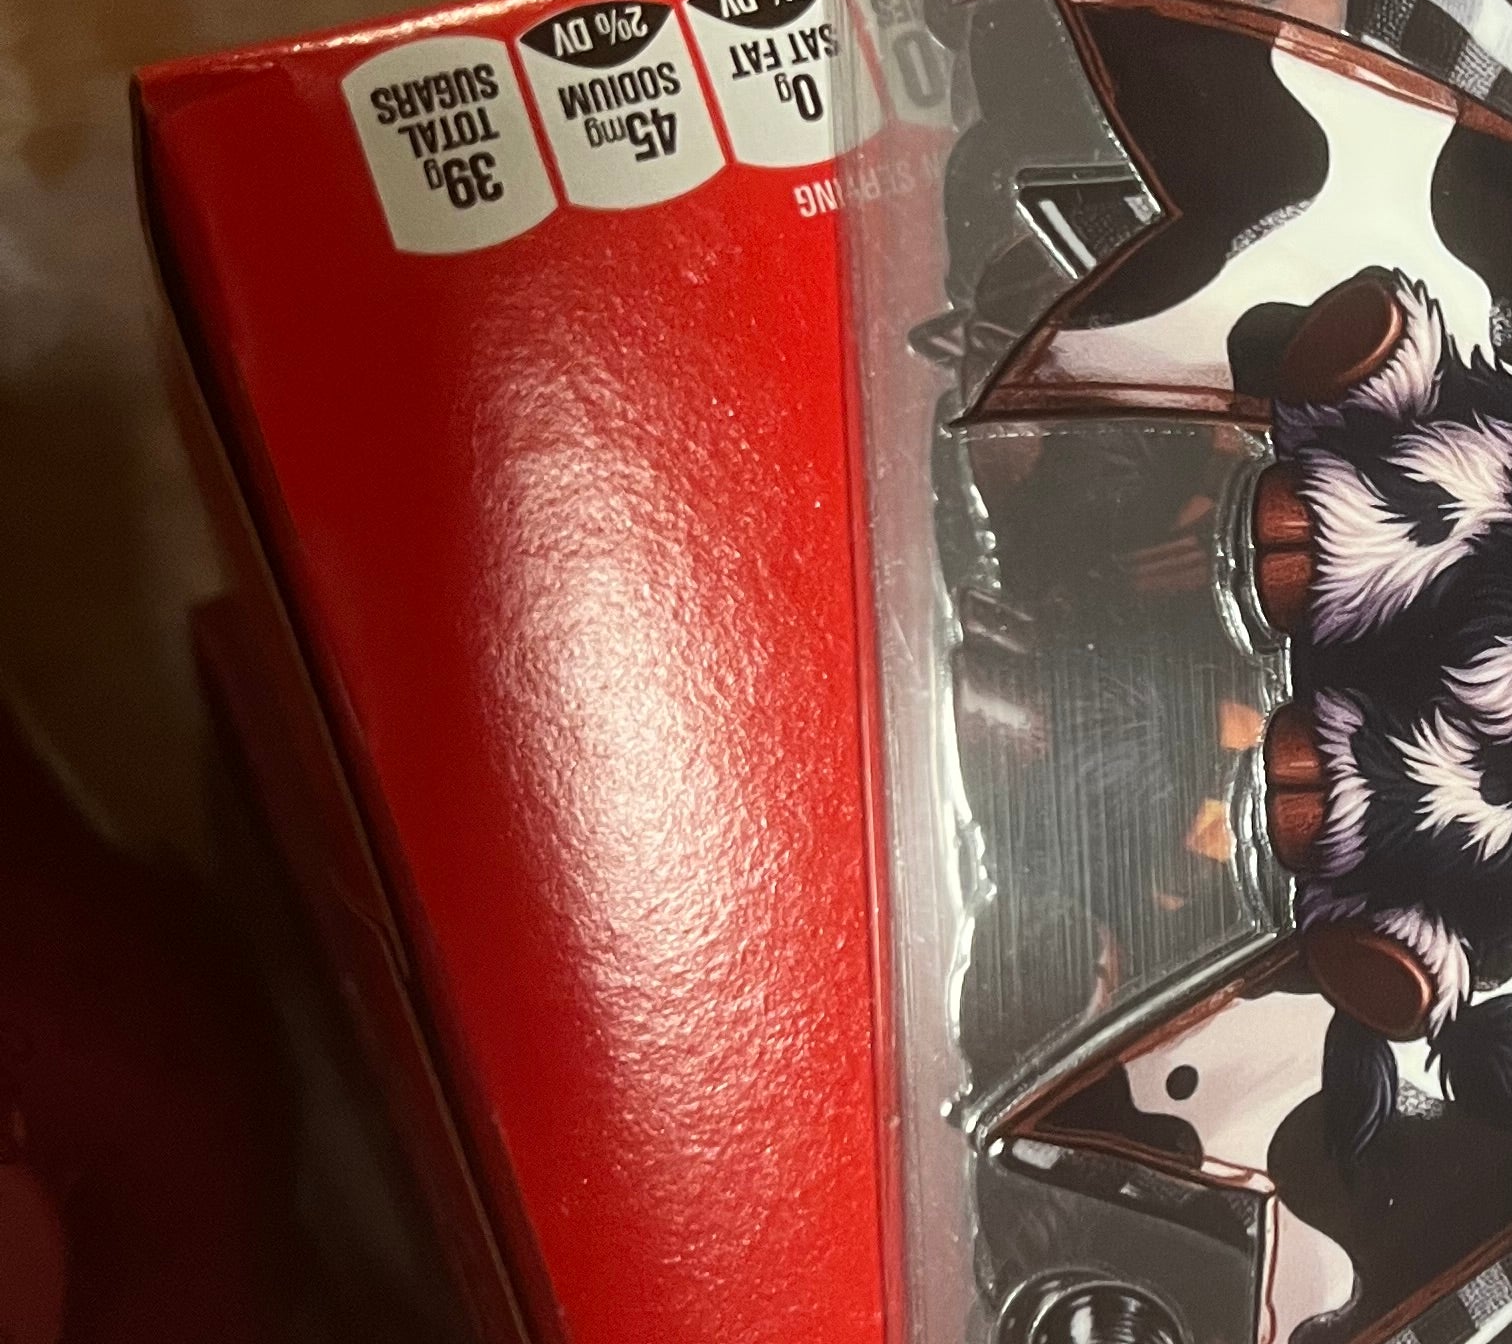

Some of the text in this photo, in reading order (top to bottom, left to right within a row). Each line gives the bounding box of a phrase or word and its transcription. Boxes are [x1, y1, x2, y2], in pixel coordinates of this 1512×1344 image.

[552, 6, 649, 56] 2% DV
[729, 23, 842, 80] SAT FAT
[370, 63, 499, 124] SUGARS
[558, 61, 681, 120] SODIUM
[774, 72, 824, 121] 0g
[397, 107, 501, 158] TOTAL
[583, 107, 678, 162] 45mg
[423, 151, 504, 209] 39g
